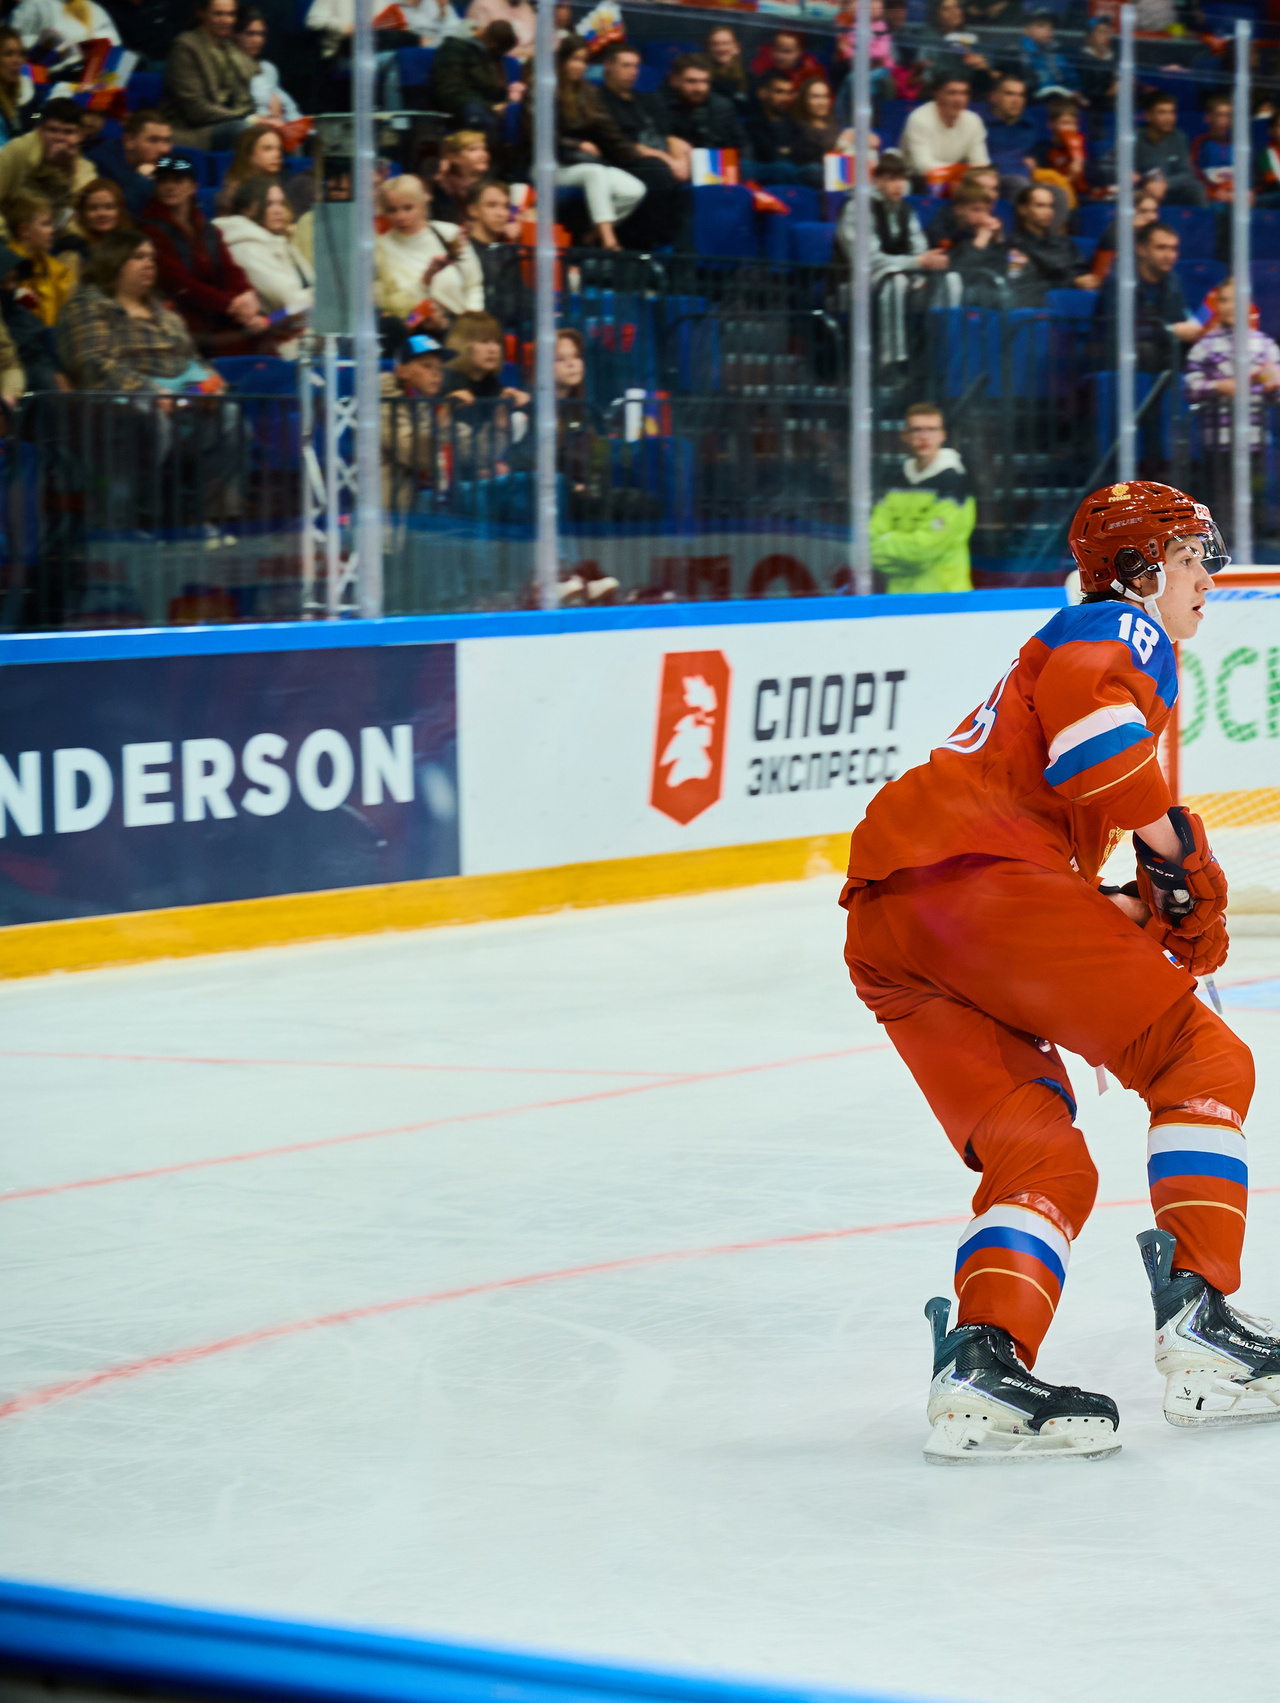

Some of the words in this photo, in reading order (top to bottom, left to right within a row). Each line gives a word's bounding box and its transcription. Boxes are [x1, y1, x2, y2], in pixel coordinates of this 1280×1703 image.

[1117, 613, 1160, 665] 18
[753, 669, 908, 741] СПОРТ
[747, 746, 899, 797] ЭКСПРЕСС
[1145, 864, 1175, 878] CCM
[1228, 1335, 1272, 1356] BAUER
[1000, 1376, 1052, 1399] BAUER
